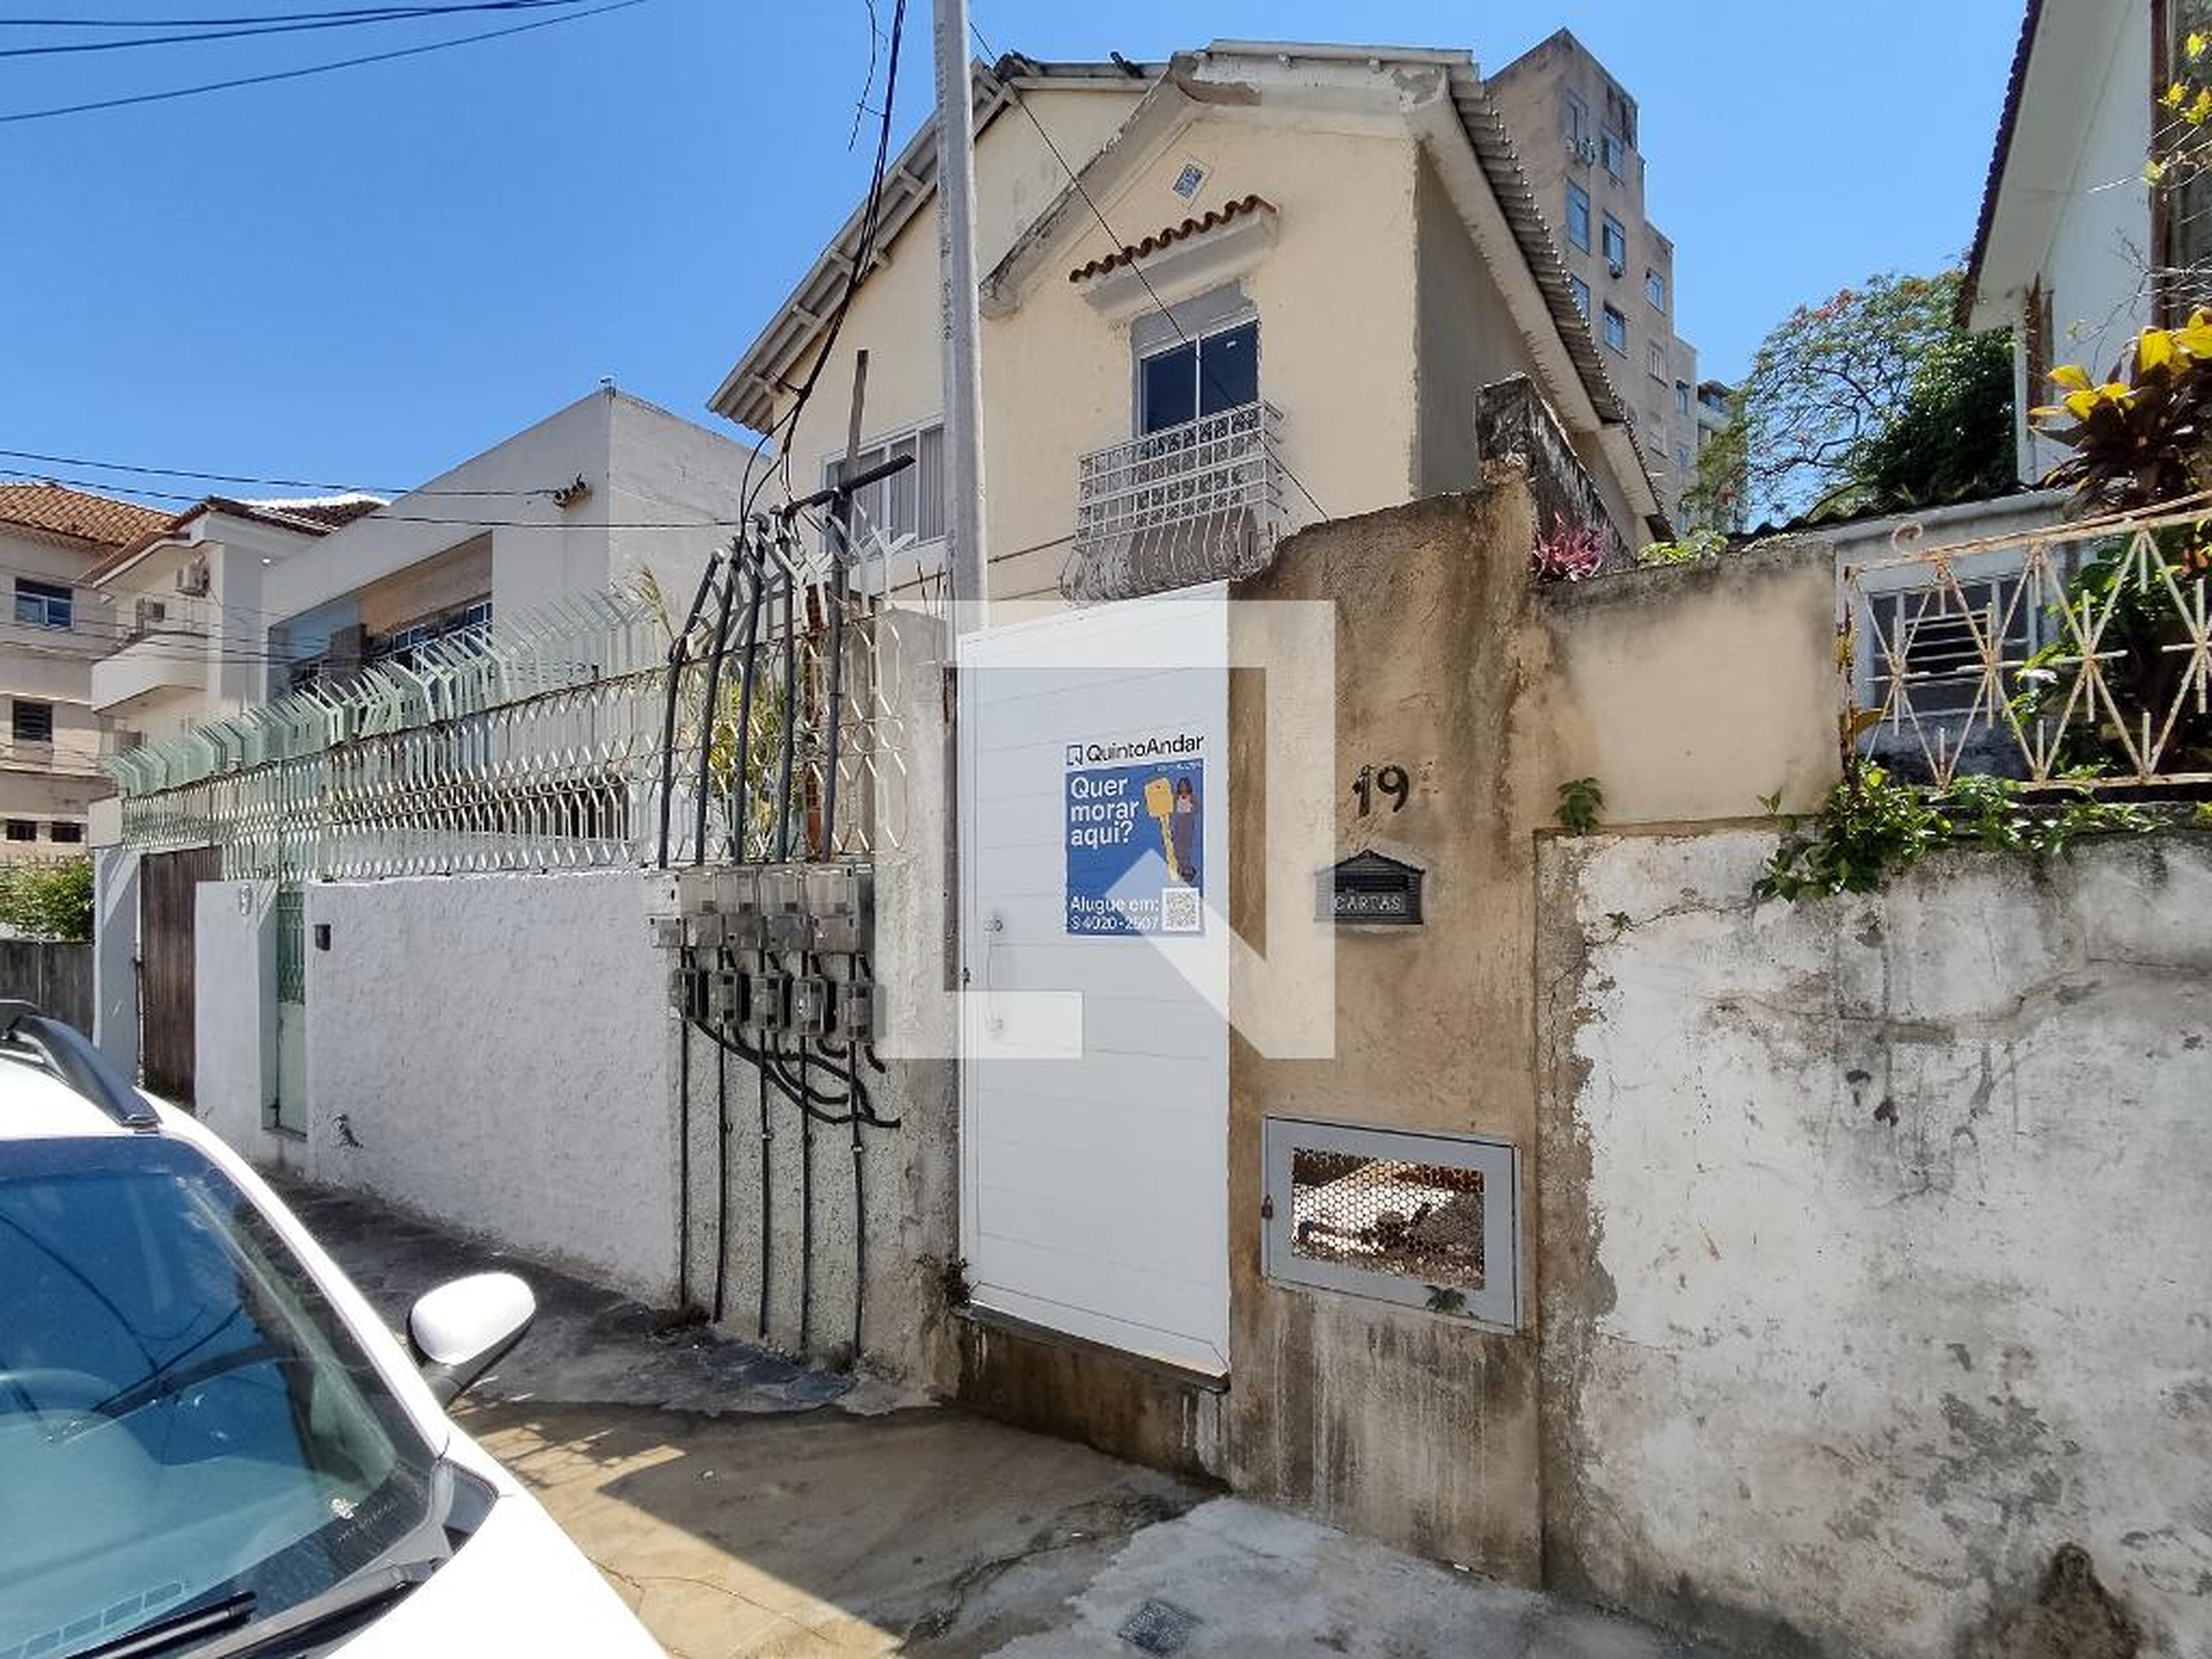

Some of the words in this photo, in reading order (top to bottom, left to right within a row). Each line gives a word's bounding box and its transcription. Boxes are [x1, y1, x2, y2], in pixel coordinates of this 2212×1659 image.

[1086, 734, 1204, 762] QuintoAndar
[1071, 777, 1128, 798] Quer
[1352, 764, 1409, 817] 19
[1071, 801, 1139, 821] morar
[1071, 820, 1132, 849] aqui?
[1070, 896, 1125, 915] Alugue
